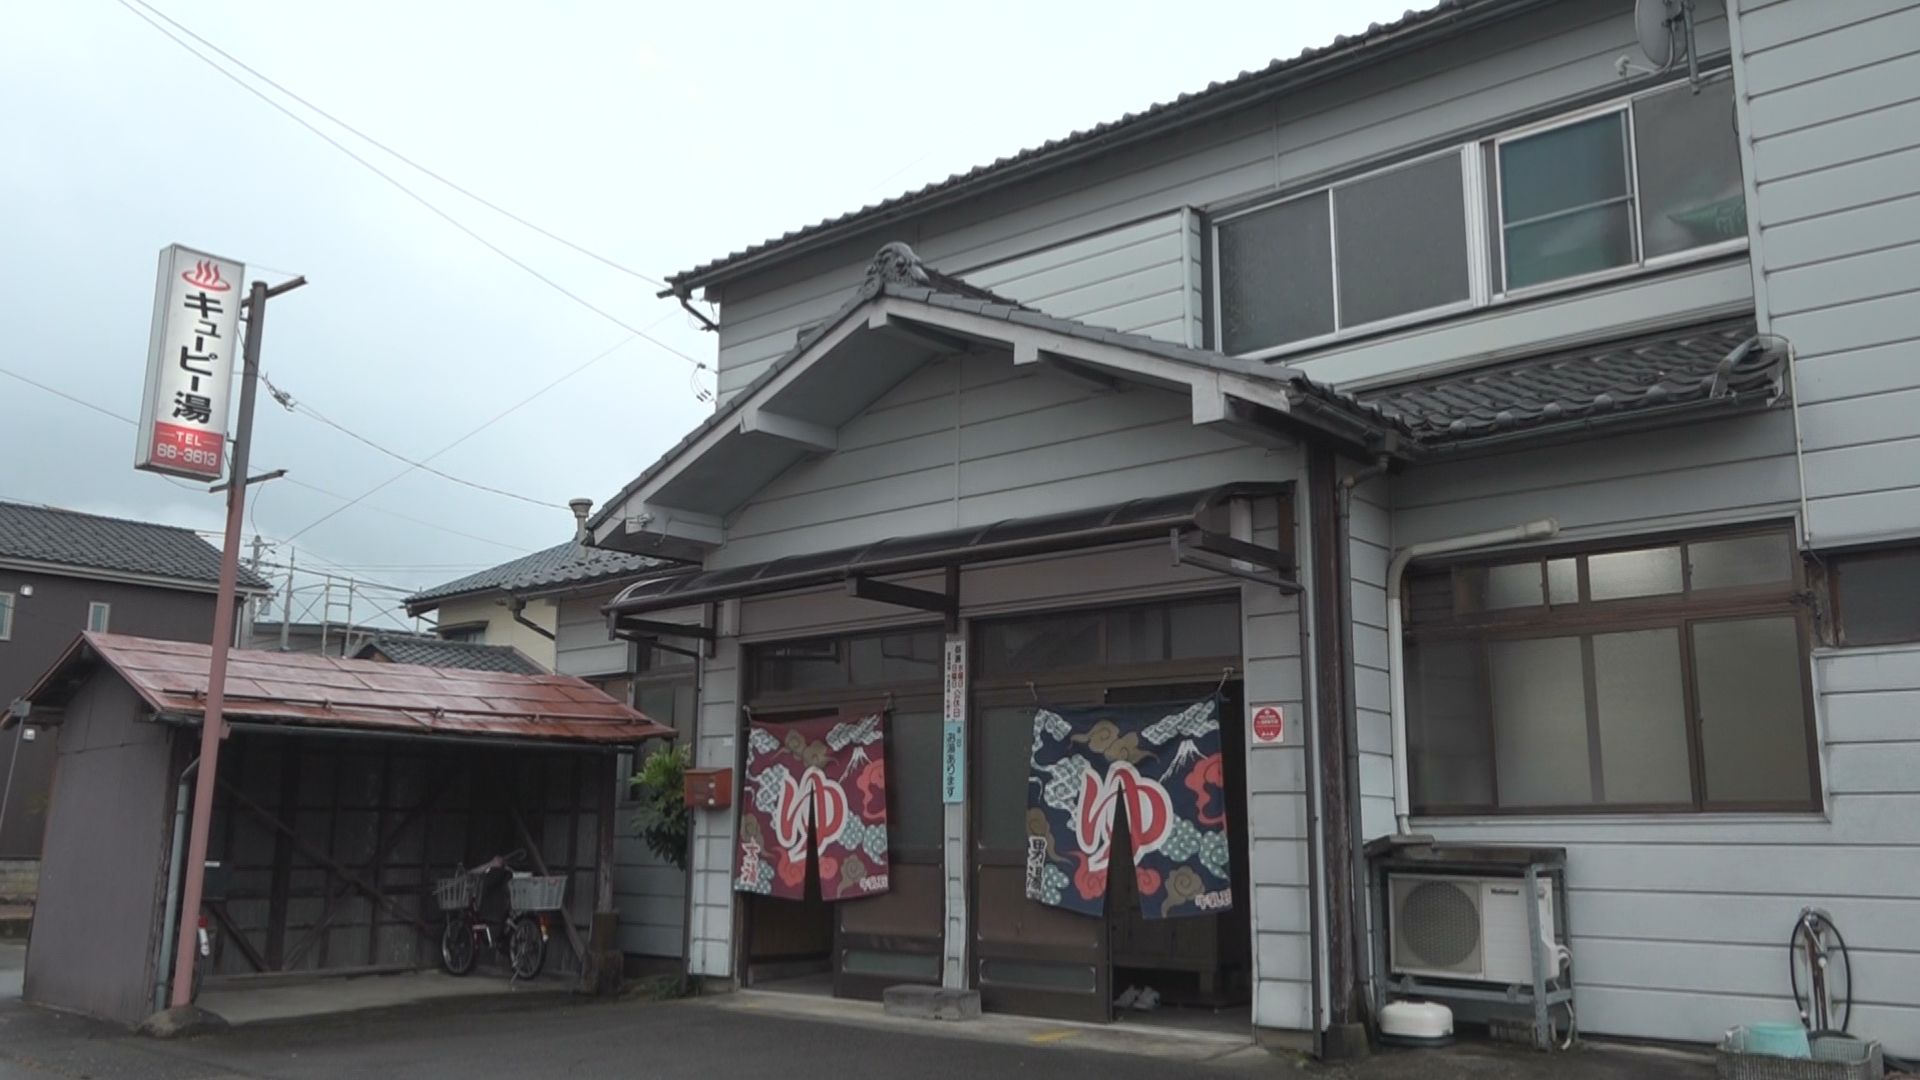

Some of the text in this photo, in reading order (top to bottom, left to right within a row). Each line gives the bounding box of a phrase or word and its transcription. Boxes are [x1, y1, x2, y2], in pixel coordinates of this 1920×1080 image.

[172, 291, 224, 424] キューピー湯
[175, 430, 203, 448] TEL
[946, 732, 956, 798] お湯あります
[777, 767, 848, 862] ゆ
[1077, 761, 1173, 871] ゆ
[1026, 836, 1047, 898] 男湯
